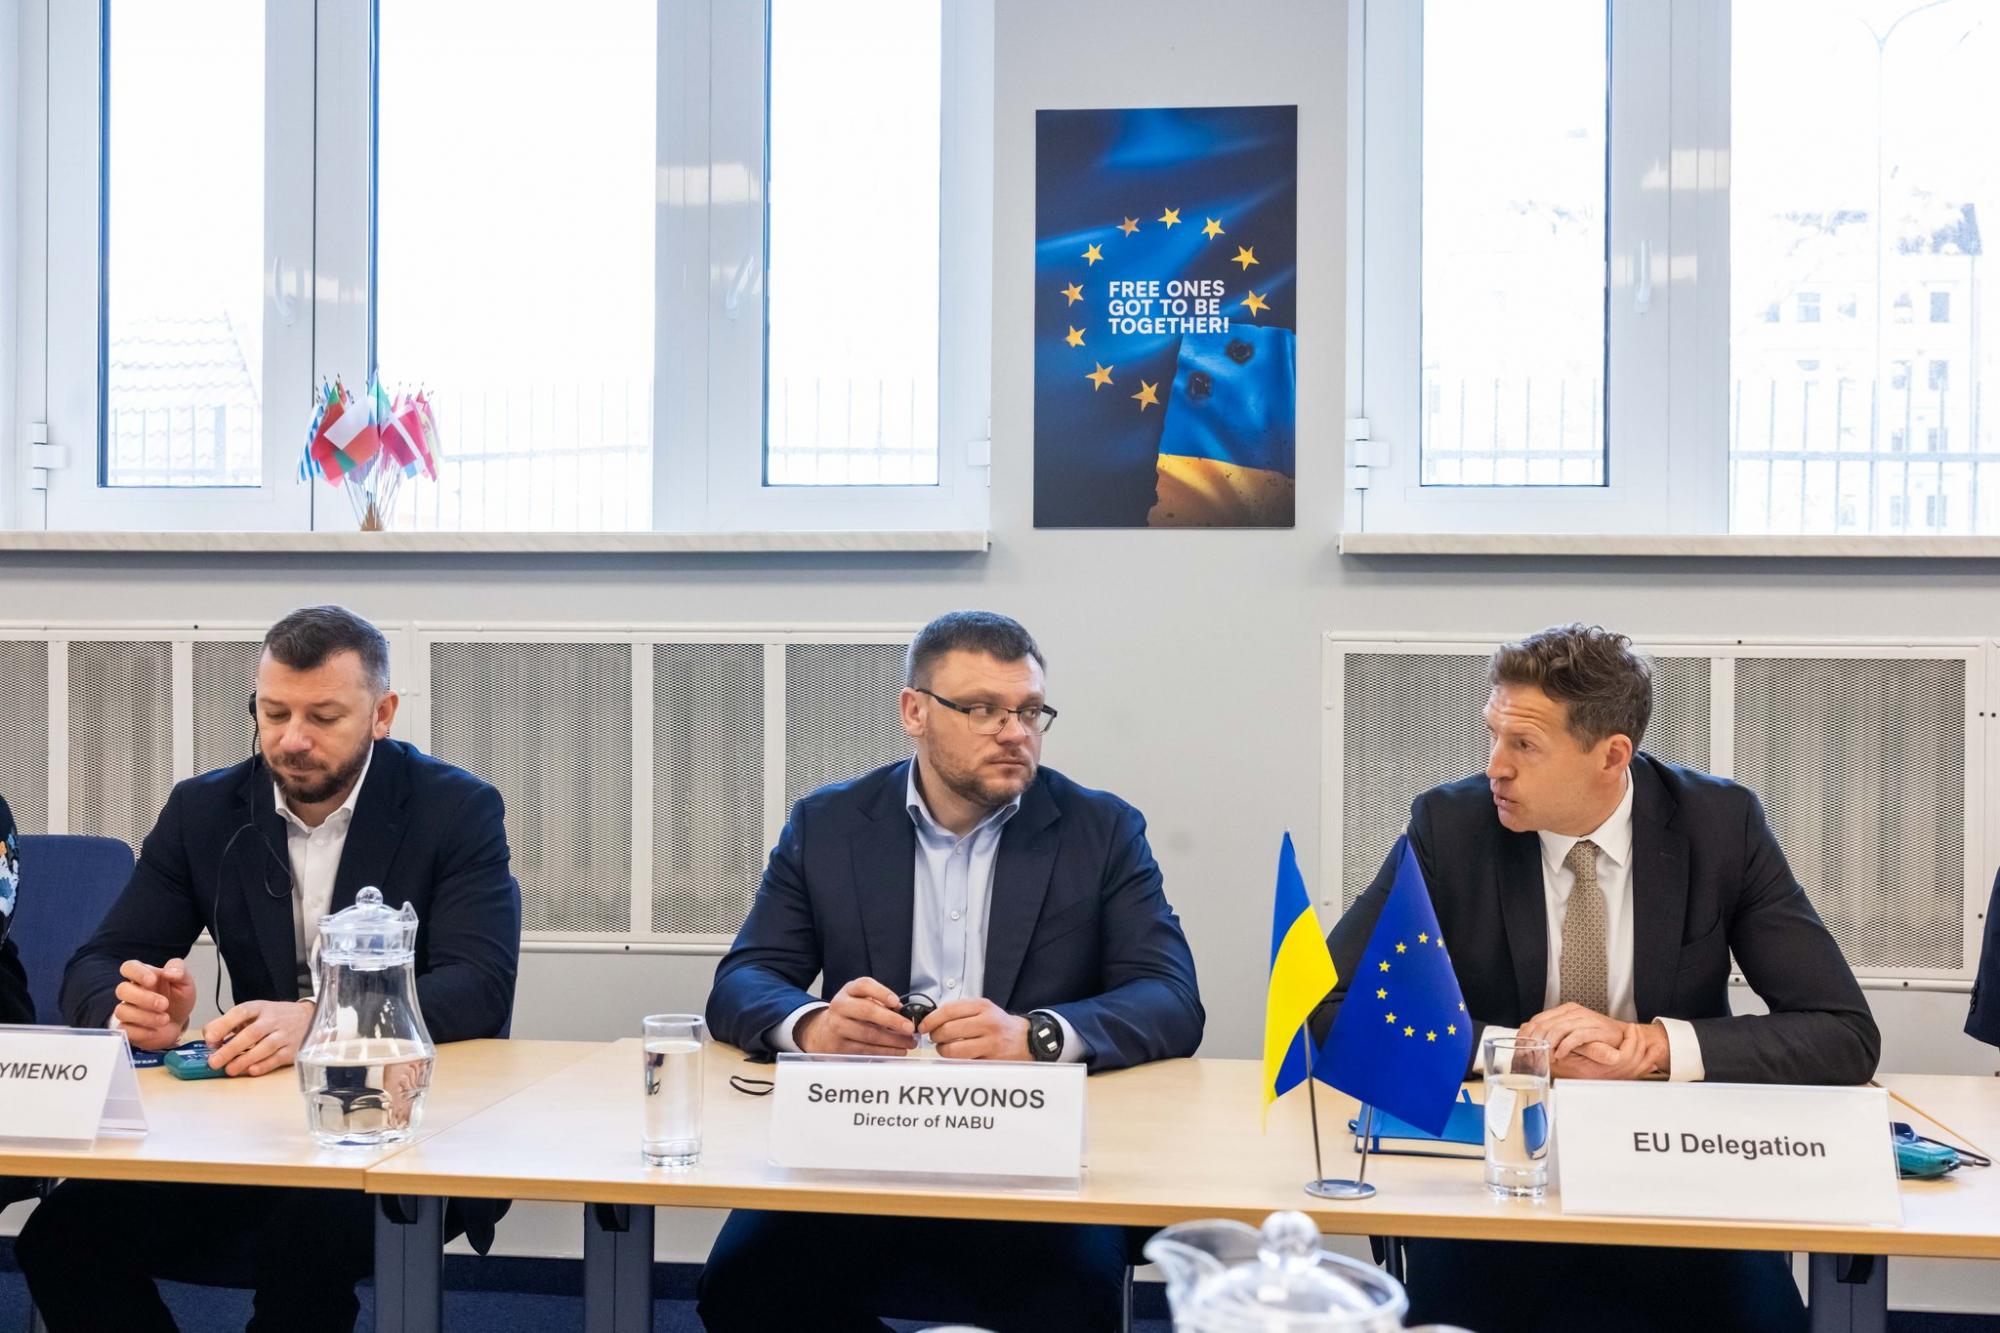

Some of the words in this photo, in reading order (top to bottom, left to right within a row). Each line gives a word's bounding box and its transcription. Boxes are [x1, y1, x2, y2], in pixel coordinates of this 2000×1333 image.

[1109, 280, 1160, 298] FREE
[1166, 279, 1225, 298] ONES
[1108, 298, 1153, 316] GOT
[1159, 298, 1188, 316] TO
[1194, 298, 1221, 316] BE
[1108, 316, 1230, 335] TOGETHER!
[808, 1083, 889, 1104] Semen
[899, 1085, 1045, 1109] KRYVONOS
[853, 1112, 920, 1127] Director
[924, 1115, 941, 1128] of
[945, 1115, 995, 1130] NABU
[1633, 1132, 1670, 1153] EU
[1680, 1133, 1826, 1160] Delegation
